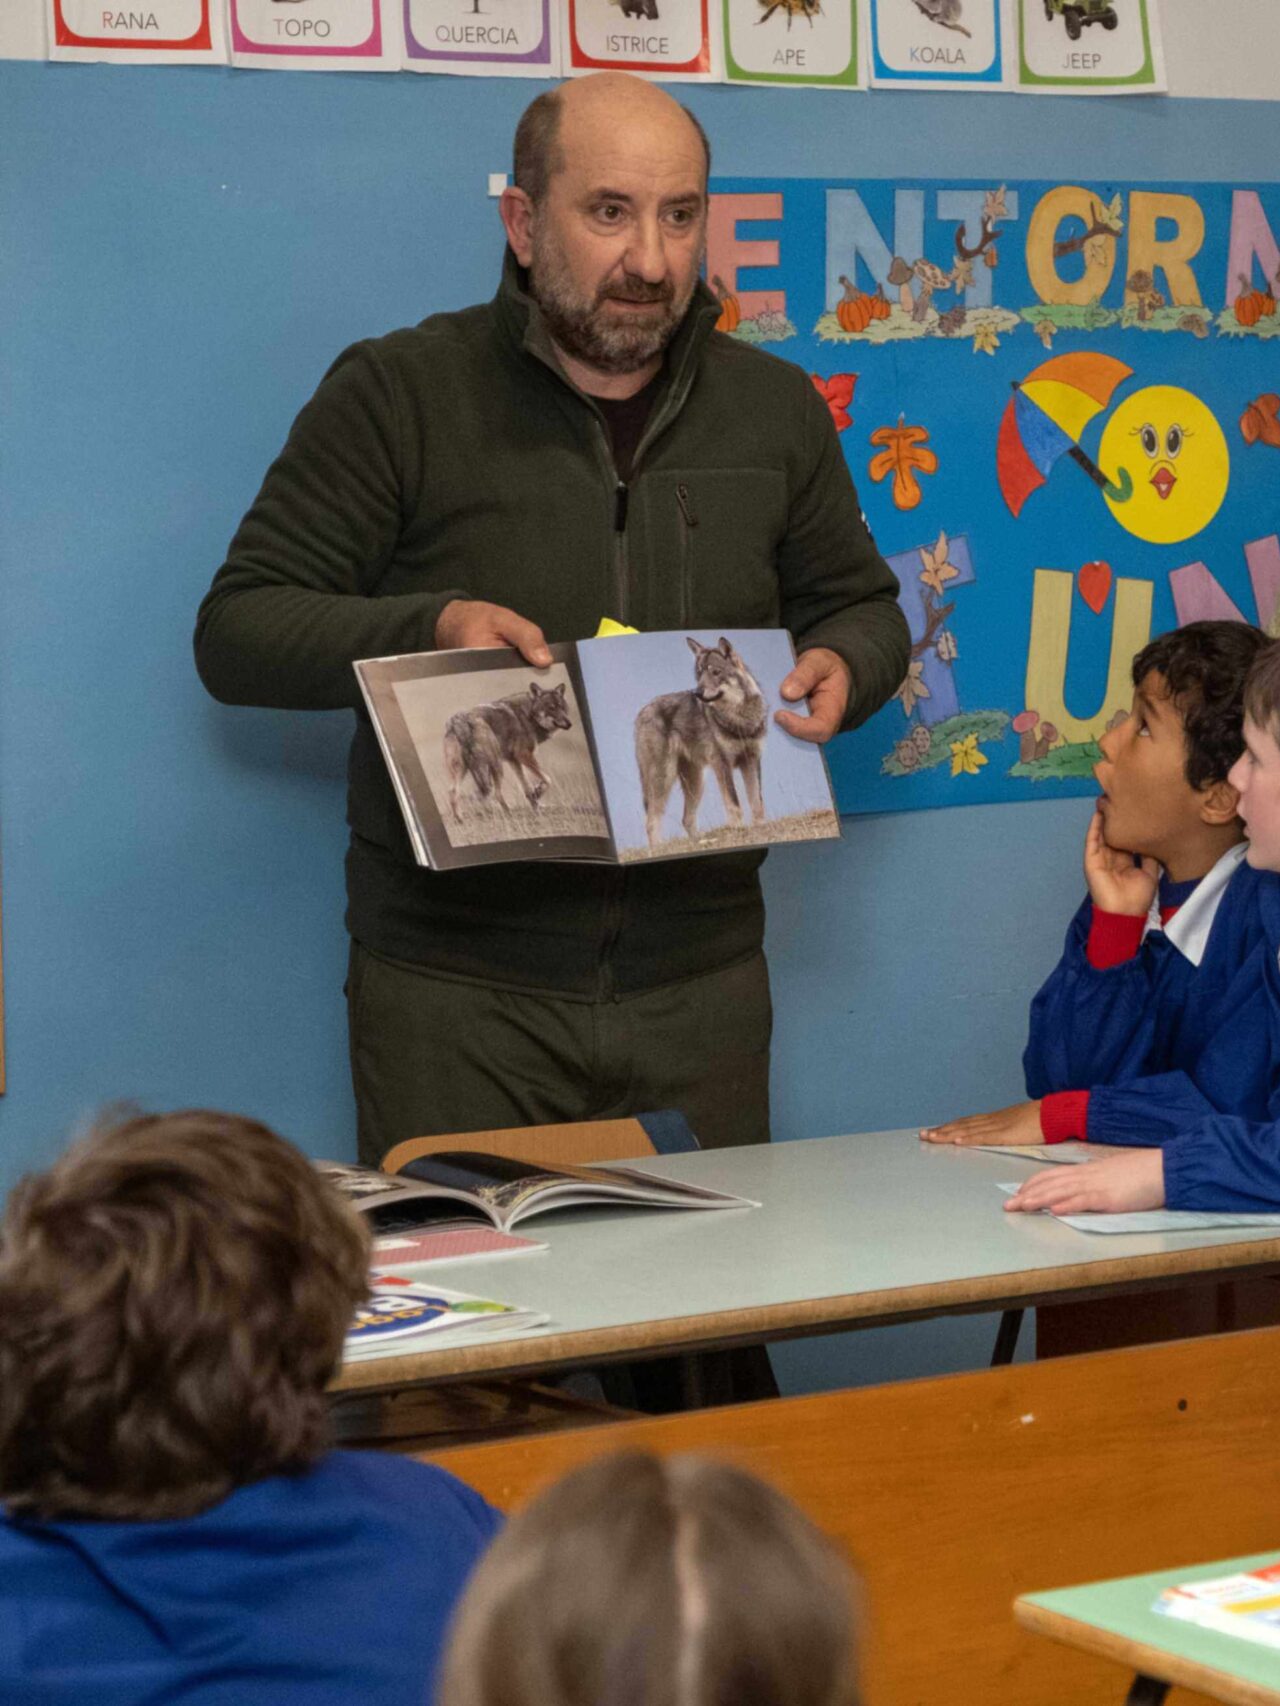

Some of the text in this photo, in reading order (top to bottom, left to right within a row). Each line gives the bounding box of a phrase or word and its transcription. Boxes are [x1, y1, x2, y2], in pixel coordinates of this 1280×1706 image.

[102, 11, 159, 29] RANA
[274, 18, 331, 38] TOPO
[435, 25, 518, 45] QUERCIA
[606, 35, 669, 55] ISTRICE
[773, 49, 806, 66] APE
[909, 47, 966, 64] KOALA
[1062, 53, 1102, 69] JEEP
